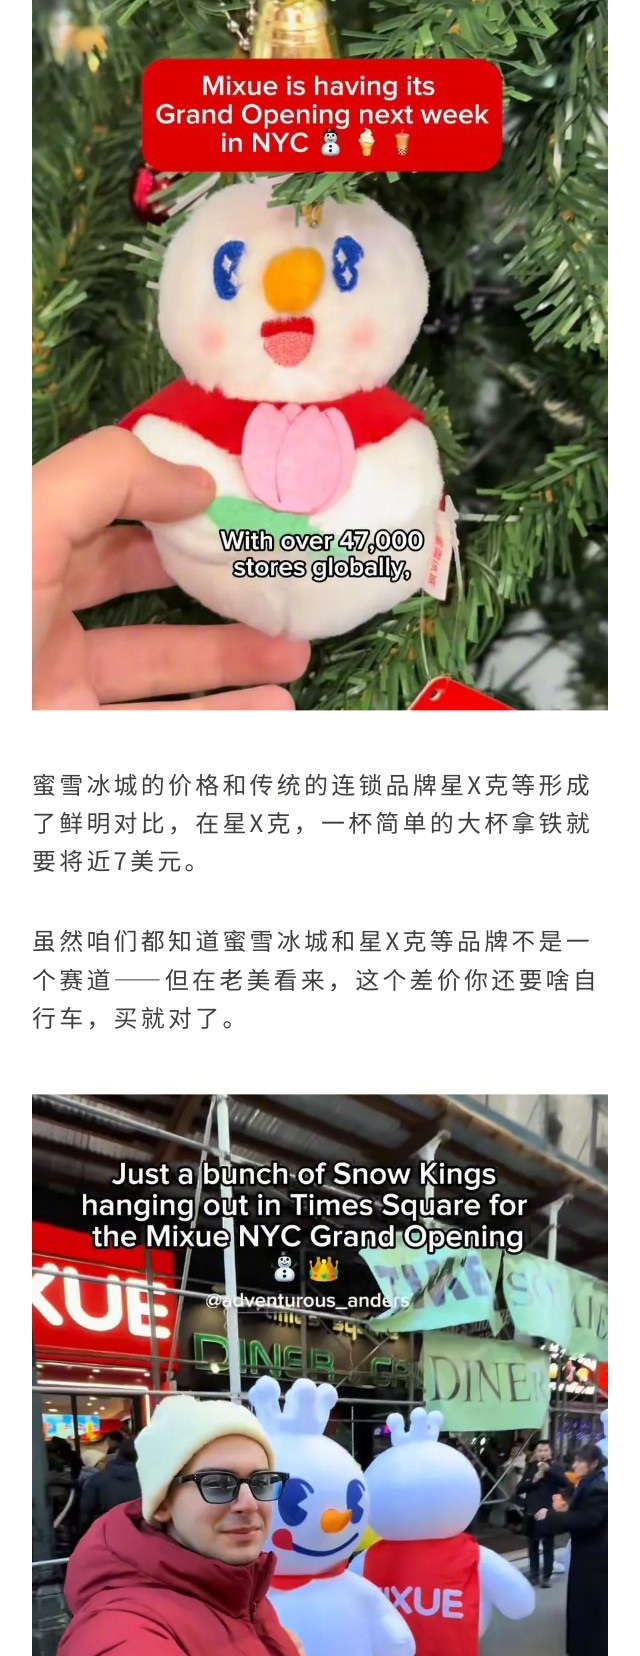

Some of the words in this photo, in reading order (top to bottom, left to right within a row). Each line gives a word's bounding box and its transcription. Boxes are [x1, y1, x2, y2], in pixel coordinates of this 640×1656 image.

[34, 774, 589, 796] 蜜雪冰城的价格和传统的连锁品牌星X克等形成
[34, 812, 589, 834] 了鲜明对比，在星X克，一杯简单的大杯拿铁就
[33, 850, 193, 872] 要将近7美元。
[33, 930, 589, 952] 虽然咱们都知道蜜雪冰城和星X克等品牌不是一
[33, 1007, 231, 1029] 行车，买就对了。
[194, 1332, 335, 1380] DINER
